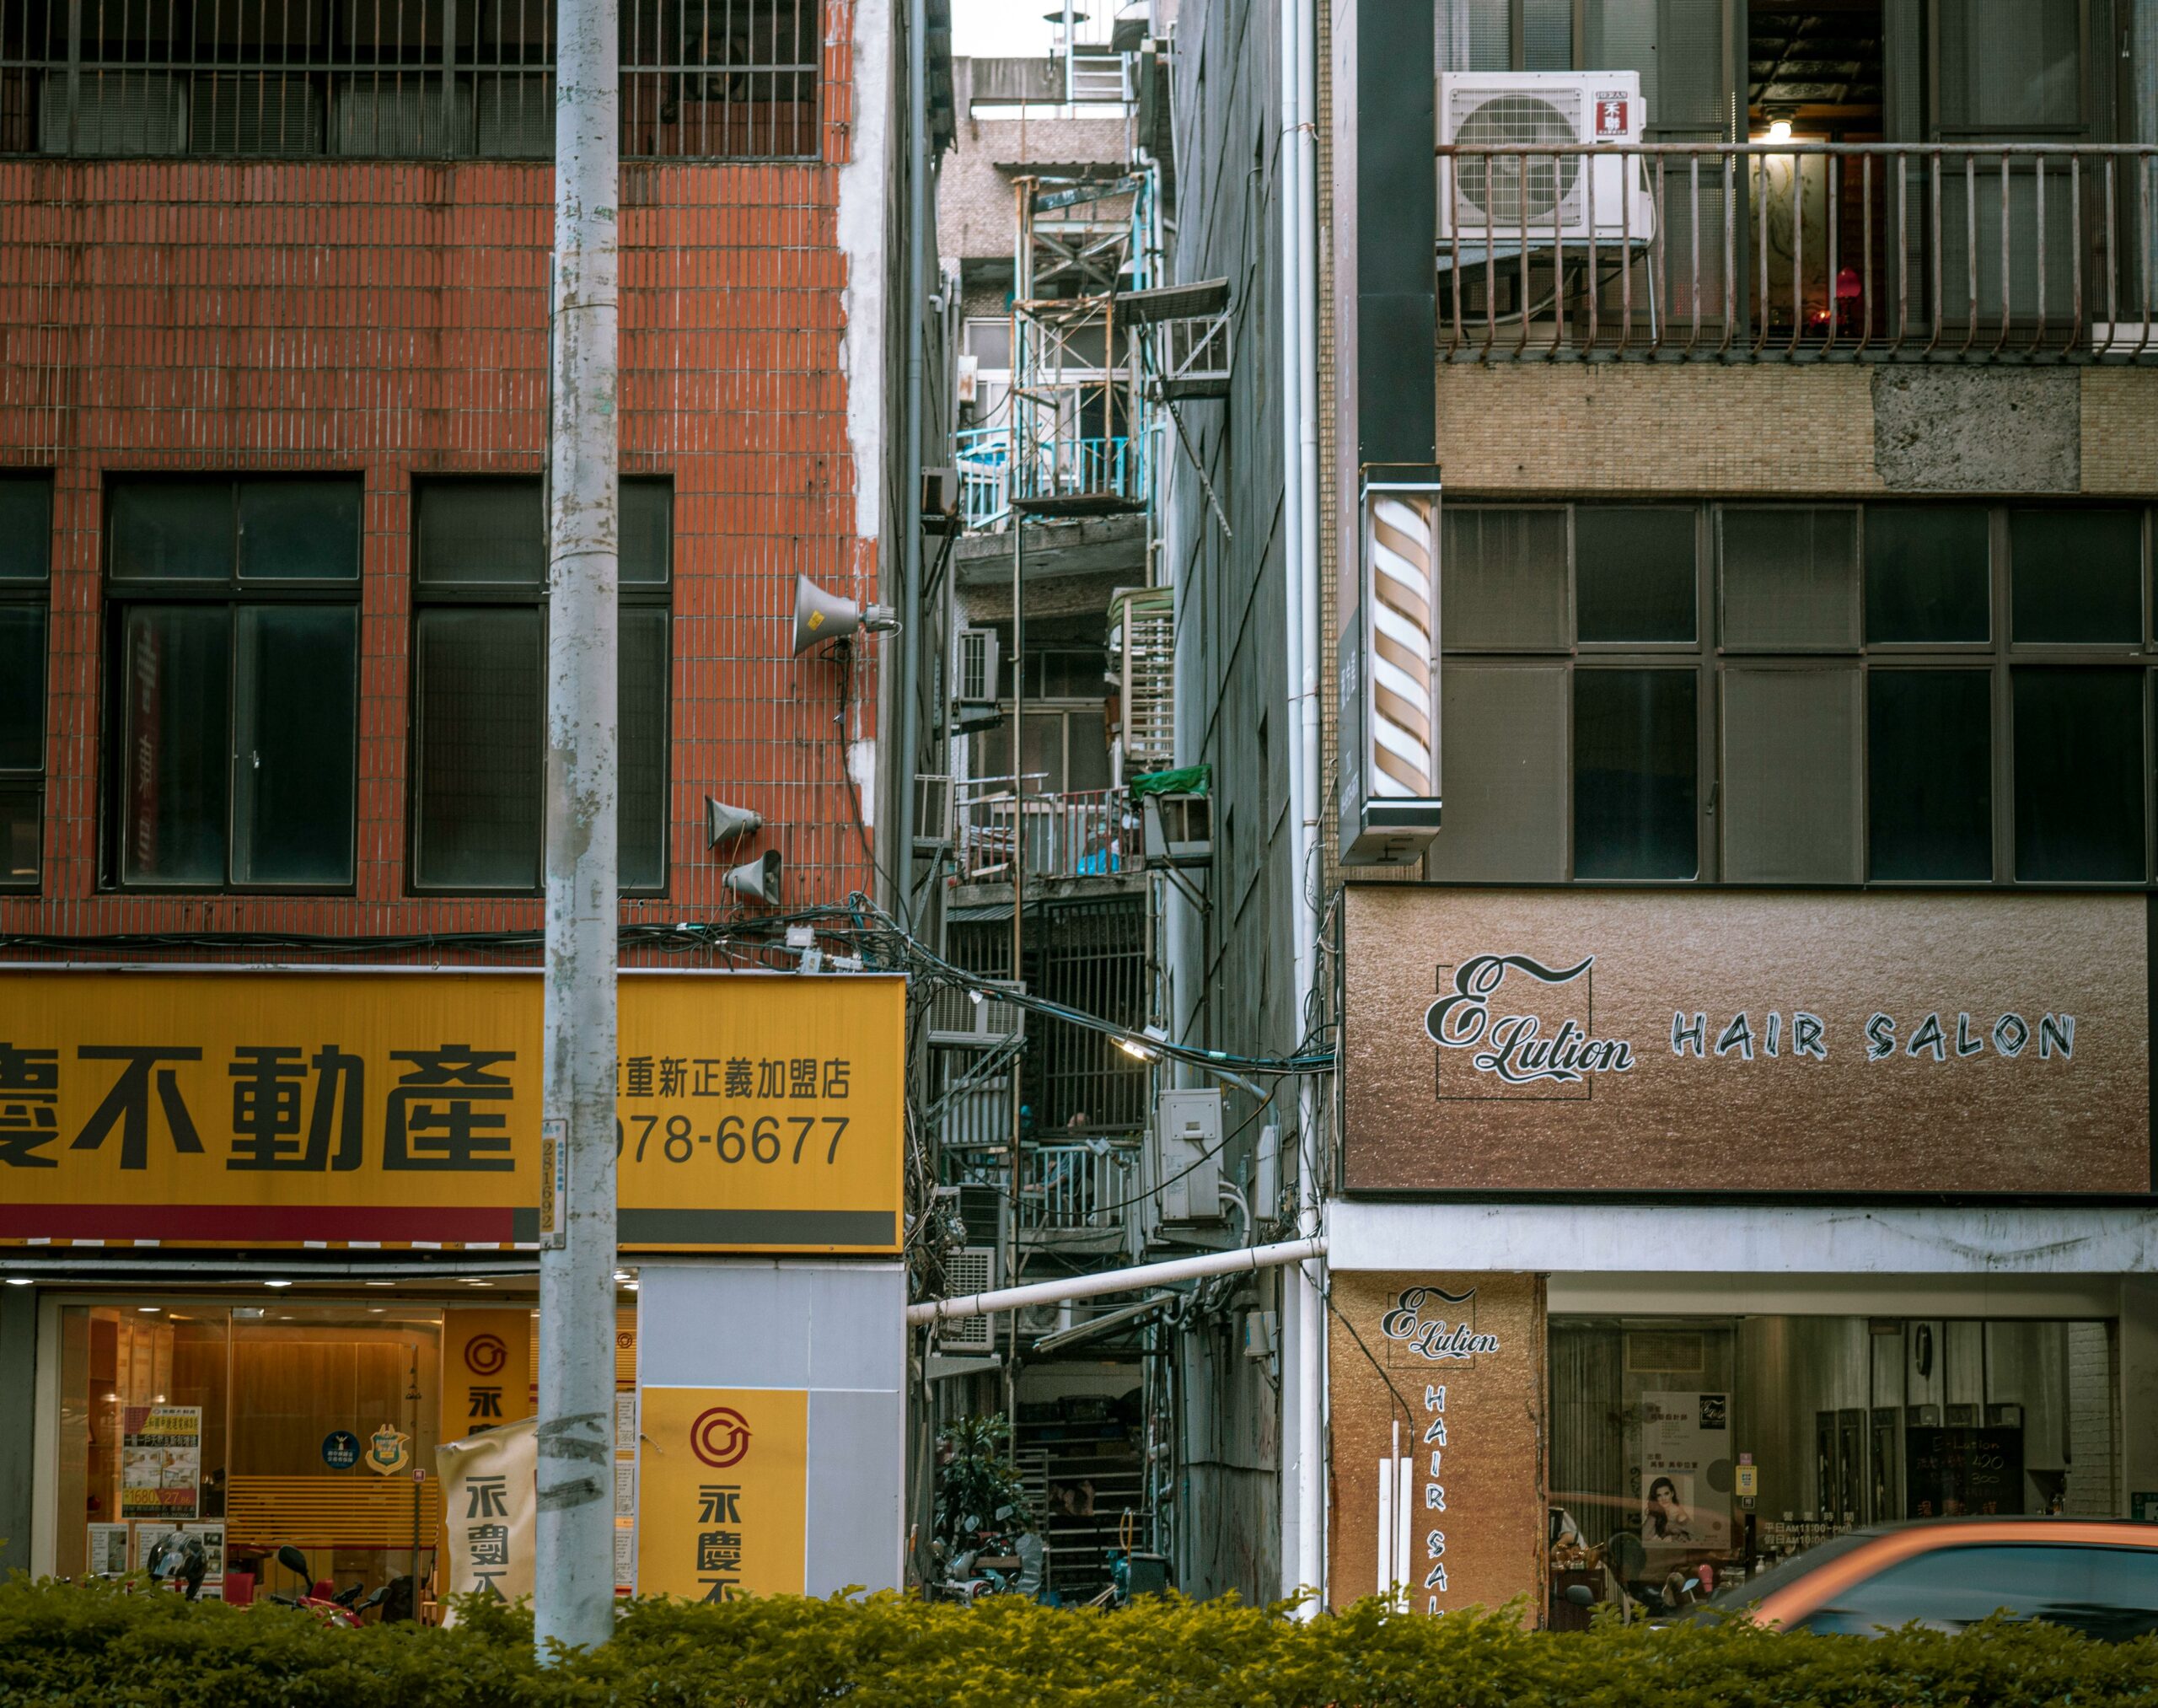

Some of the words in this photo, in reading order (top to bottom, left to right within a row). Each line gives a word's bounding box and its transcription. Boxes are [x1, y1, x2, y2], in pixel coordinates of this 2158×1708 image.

[1425, 953, 1596, 1048] E
[1473, 1014, 1636, 1085] Lution
[1671, 1010, 1828, 1061] HAIR
[1865, 1011, 2075, 1061] SALON
[617, 1056, 851, 1098] 重新正義加盟店
[617, 1114, 851, 1164] 78-6677
[1382, 1286, 1477, 1339] E
[1409, 1320, 1500, 1360] Lution
[468, 1386, 503, 1436] 永
[1424, 1384, 1447, 1512] HAIR
